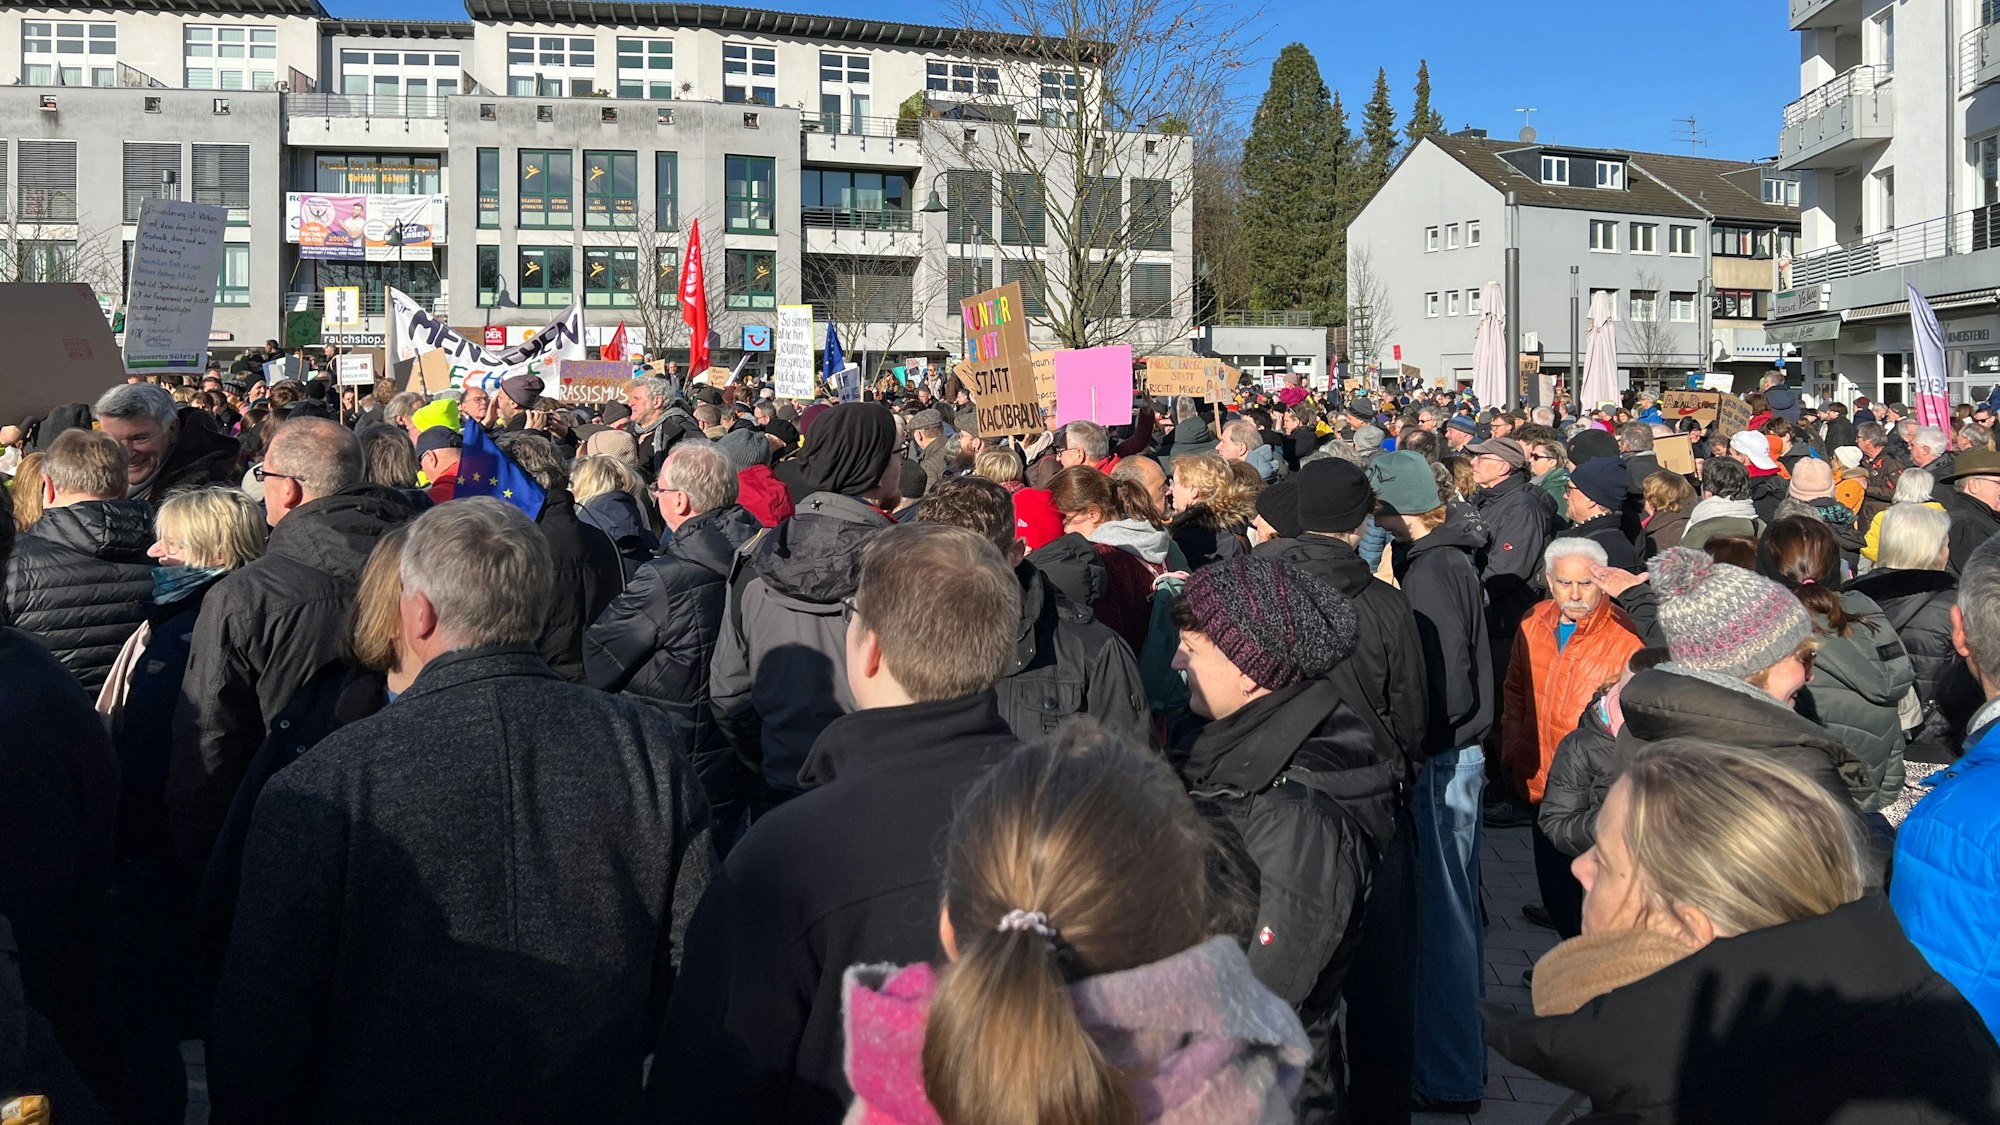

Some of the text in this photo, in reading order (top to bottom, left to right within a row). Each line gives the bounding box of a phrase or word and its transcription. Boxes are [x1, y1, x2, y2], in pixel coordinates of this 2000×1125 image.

[963, 295, 1012, 331] KUNTER
[323, 335, 386, 346] rauchshop.
[968, 331, 999, 364] BUNT
[975, 367, 1010, 396] STATT
[1149, 383, 1174, 393] RECHTE
[1170, 371, 1195, 381] STATT
[559, 384, 629, 404] RASSISMUS
[977, 401, 1043, 433] KACKBRAUN
